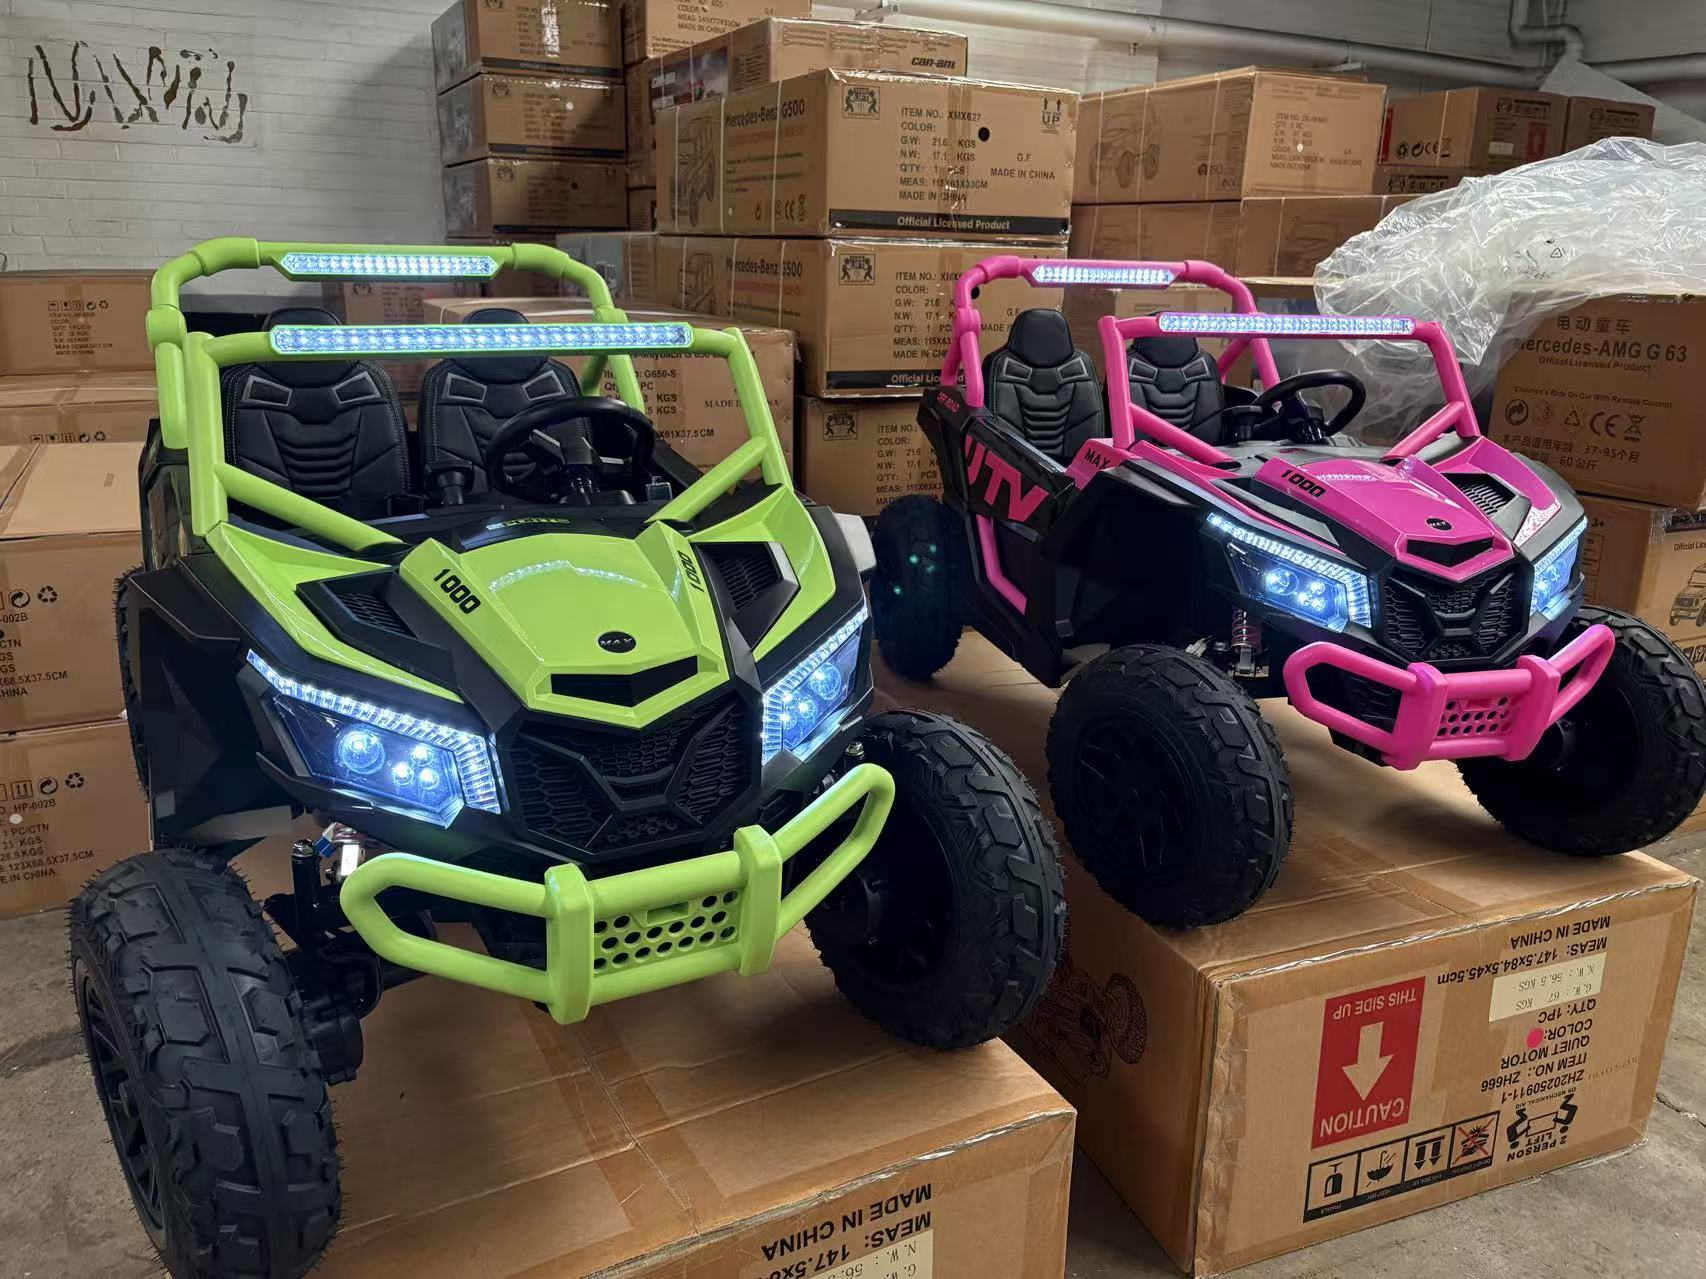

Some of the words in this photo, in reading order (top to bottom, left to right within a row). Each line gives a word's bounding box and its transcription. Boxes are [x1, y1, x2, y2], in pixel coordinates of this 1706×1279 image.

[911, 56, 956, 70] can-am
[782, 98, 805, 118] G500
[901, 107, 923, 118] ITEM
[947, 110, 982, 122] XMX627
[901, 121, 936, 132] COLOR:
[1042, 113, 1060, 125] UP
[957, 139, 977, 149] KGS
[956, 152, 976, 162] KGS
[990, 167, 1015, 178] MADE
[1017, 168, 1026, 179] IN
[1027, 169, 1055, 180] CHINA
[899, 177, 928, 187] MEAS:
[899, 191, 925, 201] MADE
[928, 191, 937, 201] IN
[897, 216, 931, 228] Official
[933, 217, 973, 229] Licensed
[975, 219, 1010, 231] Product
[726, 257, 779, 276] Mrcedes-Benz
[895, 272, 916, 281] ITEM
[895, 285, 928, 294] COLOR:
[1557, 316, 1632, 335] 电动童车
[893, 337, 920, 346] MEAS:
[893, 350, 917, 359] MADE
[920, 350, 929, 358] IN
[1646, 343, 1660, 361] G
[1665, 344, 1687, 363] 63
[643, 370, 677, 378] G650-S
[891, 374, 923, 384] Official
[656, 393, 677, 402] KGS
[704, 400, 734, 408] MADE
[656, 405, 677, 414] KGS
[878, 424, 898, 434] ITEM
[877, 437, 910, 447] COLOR:
[1084, 448, 1111, 470] MAX
[876, 484, 902, 493] MEAS:
[1280, 469, 1326, 498] 1000
[876, 497, 897, 505] MAD
[1591, 518, 1605, 528] 3+
[1673, 540, 1695, 551] Official
[677, 550, 705, 593] 1000
[433, 568, 482, 615] 1000
[600, 637, 633, 647] MAX
[0, 687, 28, 699] HINA
[14, 798, 56, 813] HP-002B
[19, 836, 43, 847] KGS
[22, 846, 44, 858] KGS
[10, 873, 21, 883] IN
[23, 868, 57, 881] CHINA
[1573, 915, 1611, 932] MADE
[1510, 929, 1552, 949] CHINA
[1555, 926, 1569, 939] IN
[1566, 937, 1607, 956] MEAS:
[1437, 948, 1558, 985] 147.5x84.5x45.5cm
[1518, 980, 1536, 992] KGS
[1355, 995, 1385, 1015] SIDE
[1388, 988, 1417, 1008] THIS
[1515, 997, 1533, 1011] KGS
[1333, 1004, 1351, 1020] UP
[1538, 1005, 1563, 1024] 1PC
[1567, 998, 1597, 1016] QTY:
[1543, 1018, 1593, 1041] COLOR:
[1553, 1035, 1590, 1054] QUIET
[1501, 1047, 1549, 1070] MOTOR
[1557, 1052, 1588, 1070] ITEM
[1481, 1071, 1521, 1092] ZH666
[1501, 1069, 1585, 1104] ZH20250911-1
[1515, 1101, 1526, 1109] AID
[1528, 1089, 1567, 1106] MECHANICAL
[1320, 1097, 1405, 1137] CAUTION
[1525, 1132, 1553, 1147] LIFT
[1560, 1135, 1568, 1145] 2
[1507, 1140, 1557, 1161] PERSON
[869, 1183, 932, 1221] MADE
[842, 1208, 863, 1232] IN
[864, 1211, 931, 1248] MEAS:
[761, 1220, 835, 1261] CHINA
